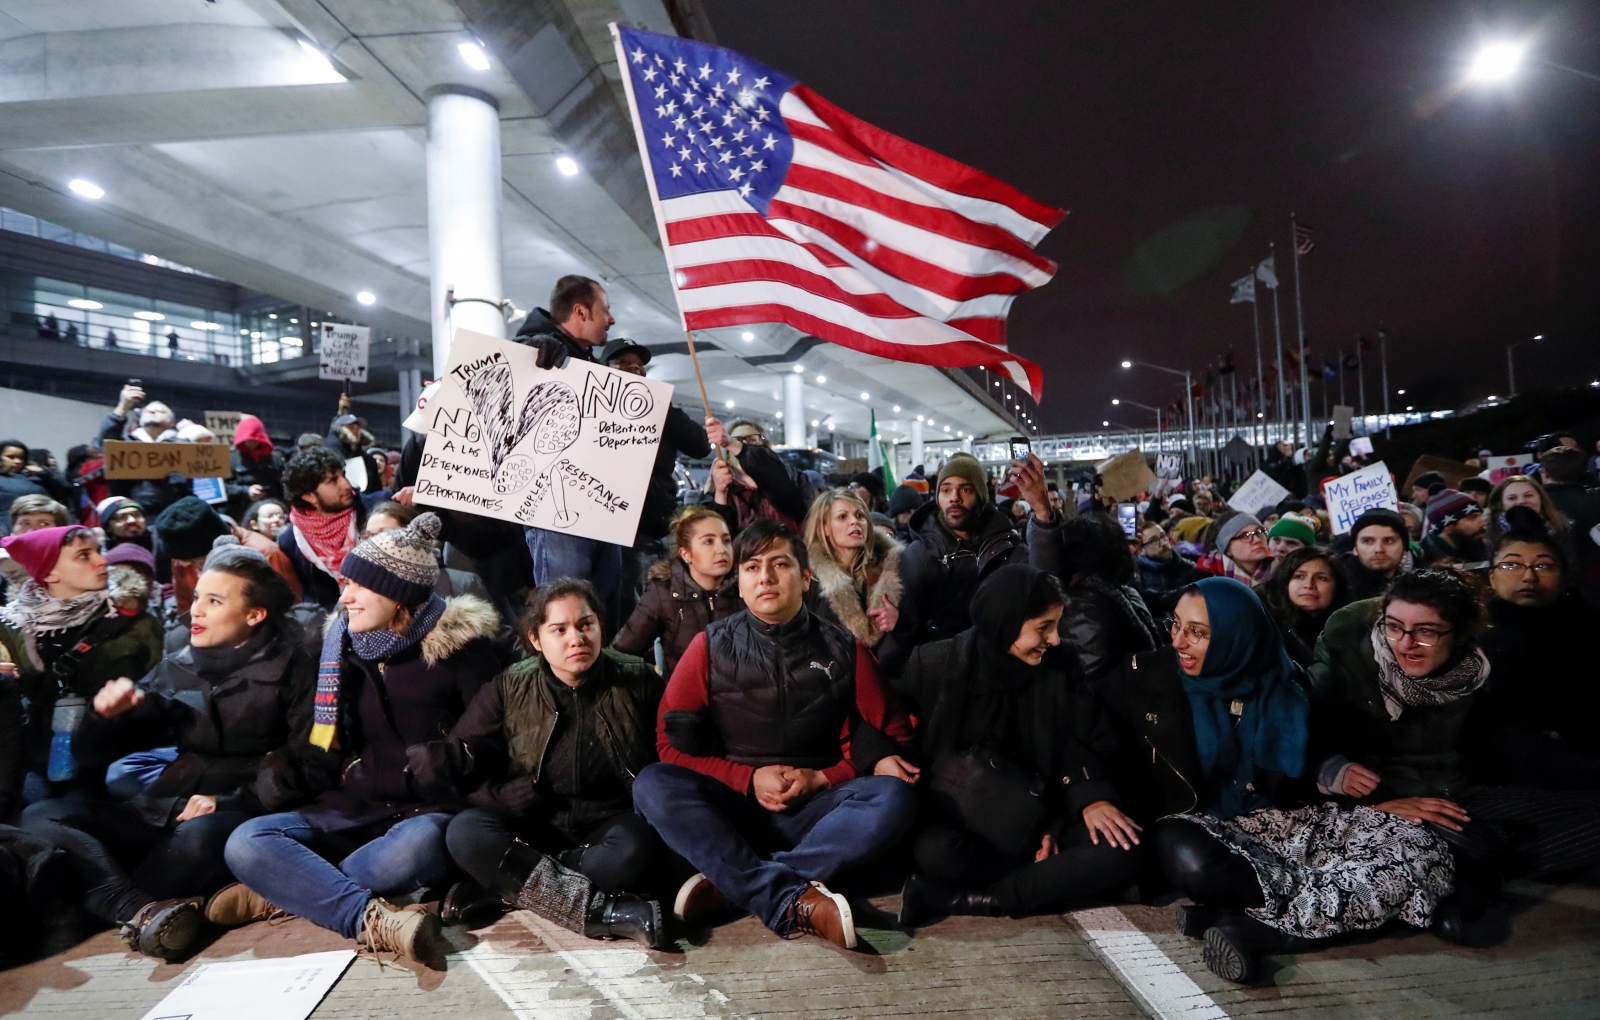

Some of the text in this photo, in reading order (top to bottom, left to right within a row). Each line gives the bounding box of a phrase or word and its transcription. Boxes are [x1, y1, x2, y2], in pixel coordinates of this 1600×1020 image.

[325, 326, 357, 340] Trump
[321, 363, 365, 377] THREAT
[450, 352, 501, 381] TRUMP
[417, 398, 427, 410] C
[581, 370, 654, 420] NO
[195, 444, 214, 457] NO
[442, 440, 481, 457] A LAS
[109, 451, 182, 471] NO BAN
[186, 459, 222, 474] WALL
[422, 453, 490, 479] DETENCIONES
[557, 458, 630, 511] RESISTANCE
[562, 474, 616, 514] POPULAR
[1353, 475, 1384, 494] FAMILY
[416, 479, 503, 512] DEPORTACIONES
[1340, 489, 1390, 512] BELONGS
